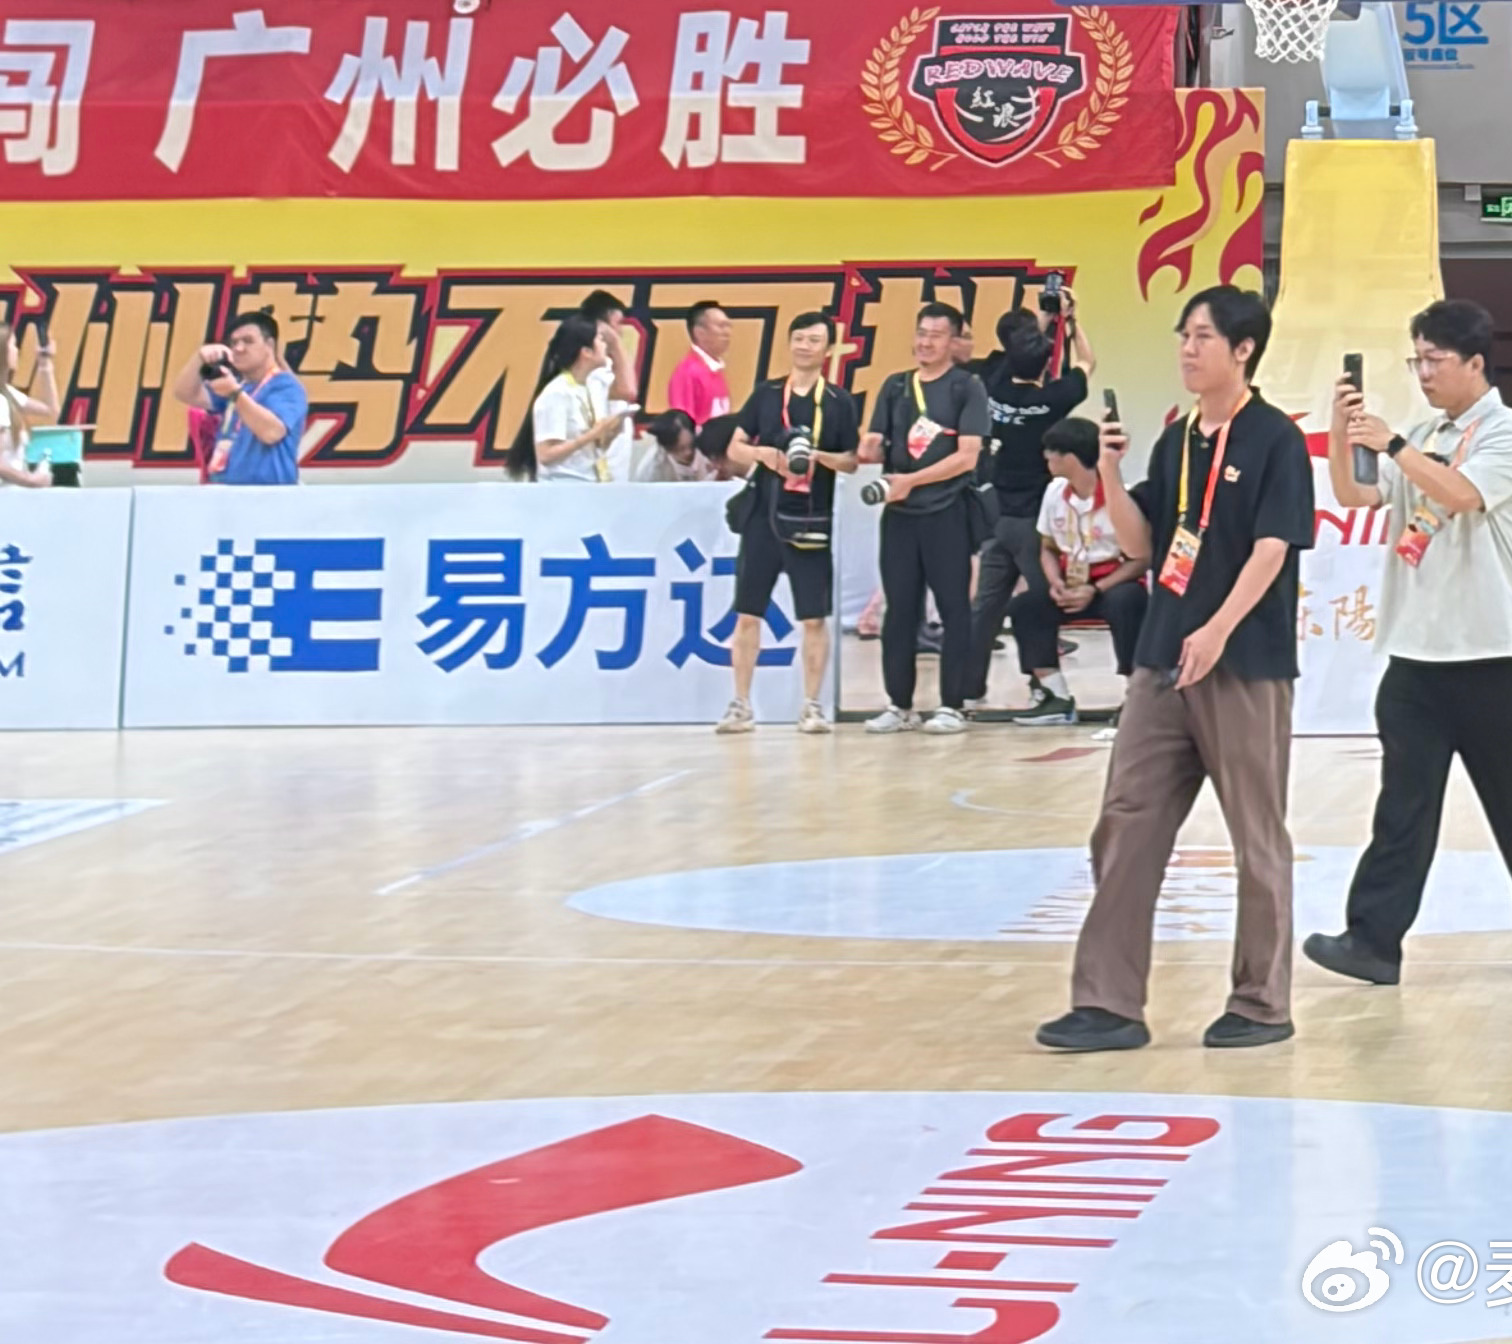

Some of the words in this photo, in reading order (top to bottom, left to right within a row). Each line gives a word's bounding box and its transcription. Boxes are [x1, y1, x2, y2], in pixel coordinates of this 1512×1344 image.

[924, 58, 1074, 86] REDWAVE
[1403, 1, 1490, 45] 5区
[154, 9, 812, 174] 广州必胜
[762, 1111, 1222, 1344] LI-NING
